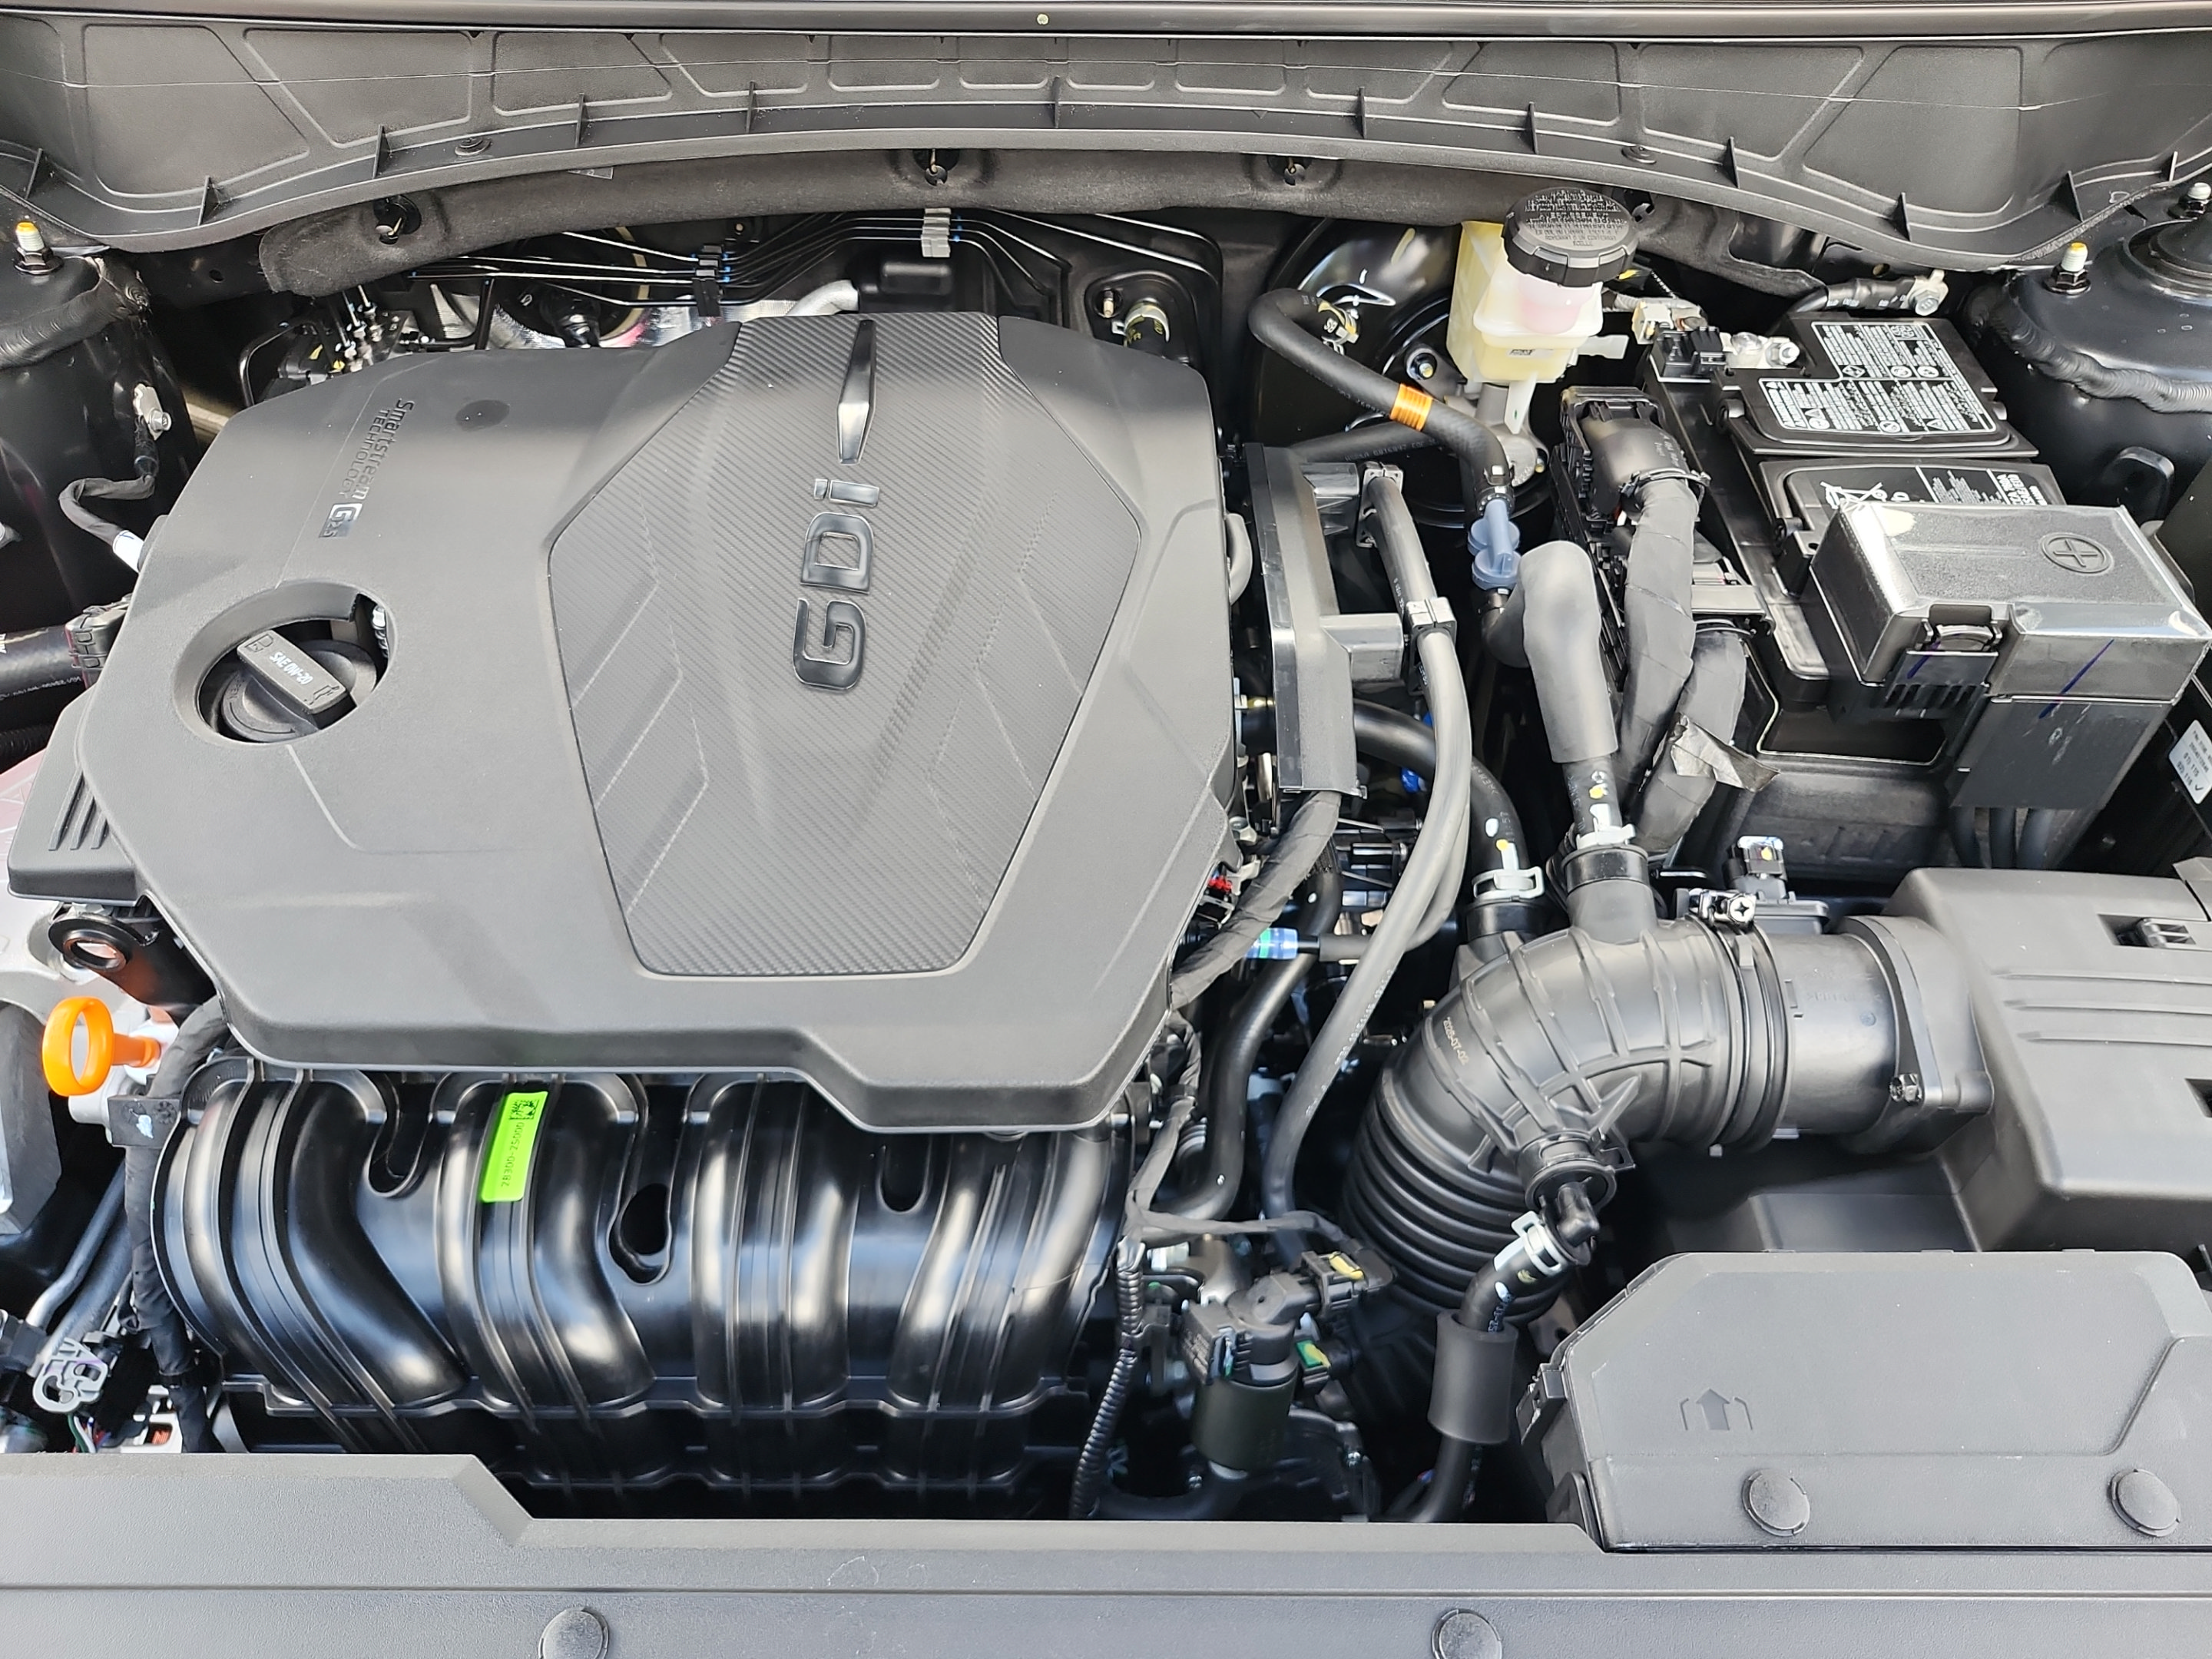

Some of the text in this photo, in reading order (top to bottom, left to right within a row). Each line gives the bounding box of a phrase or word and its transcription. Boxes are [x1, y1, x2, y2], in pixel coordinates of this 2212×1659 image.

[339, 409, 390, 499] TECHNOLOGY
[351, 397, 416, 500] Smartstream
[793, 478, 880, 690] GDi
[269, 651, 291, 669] SAE
